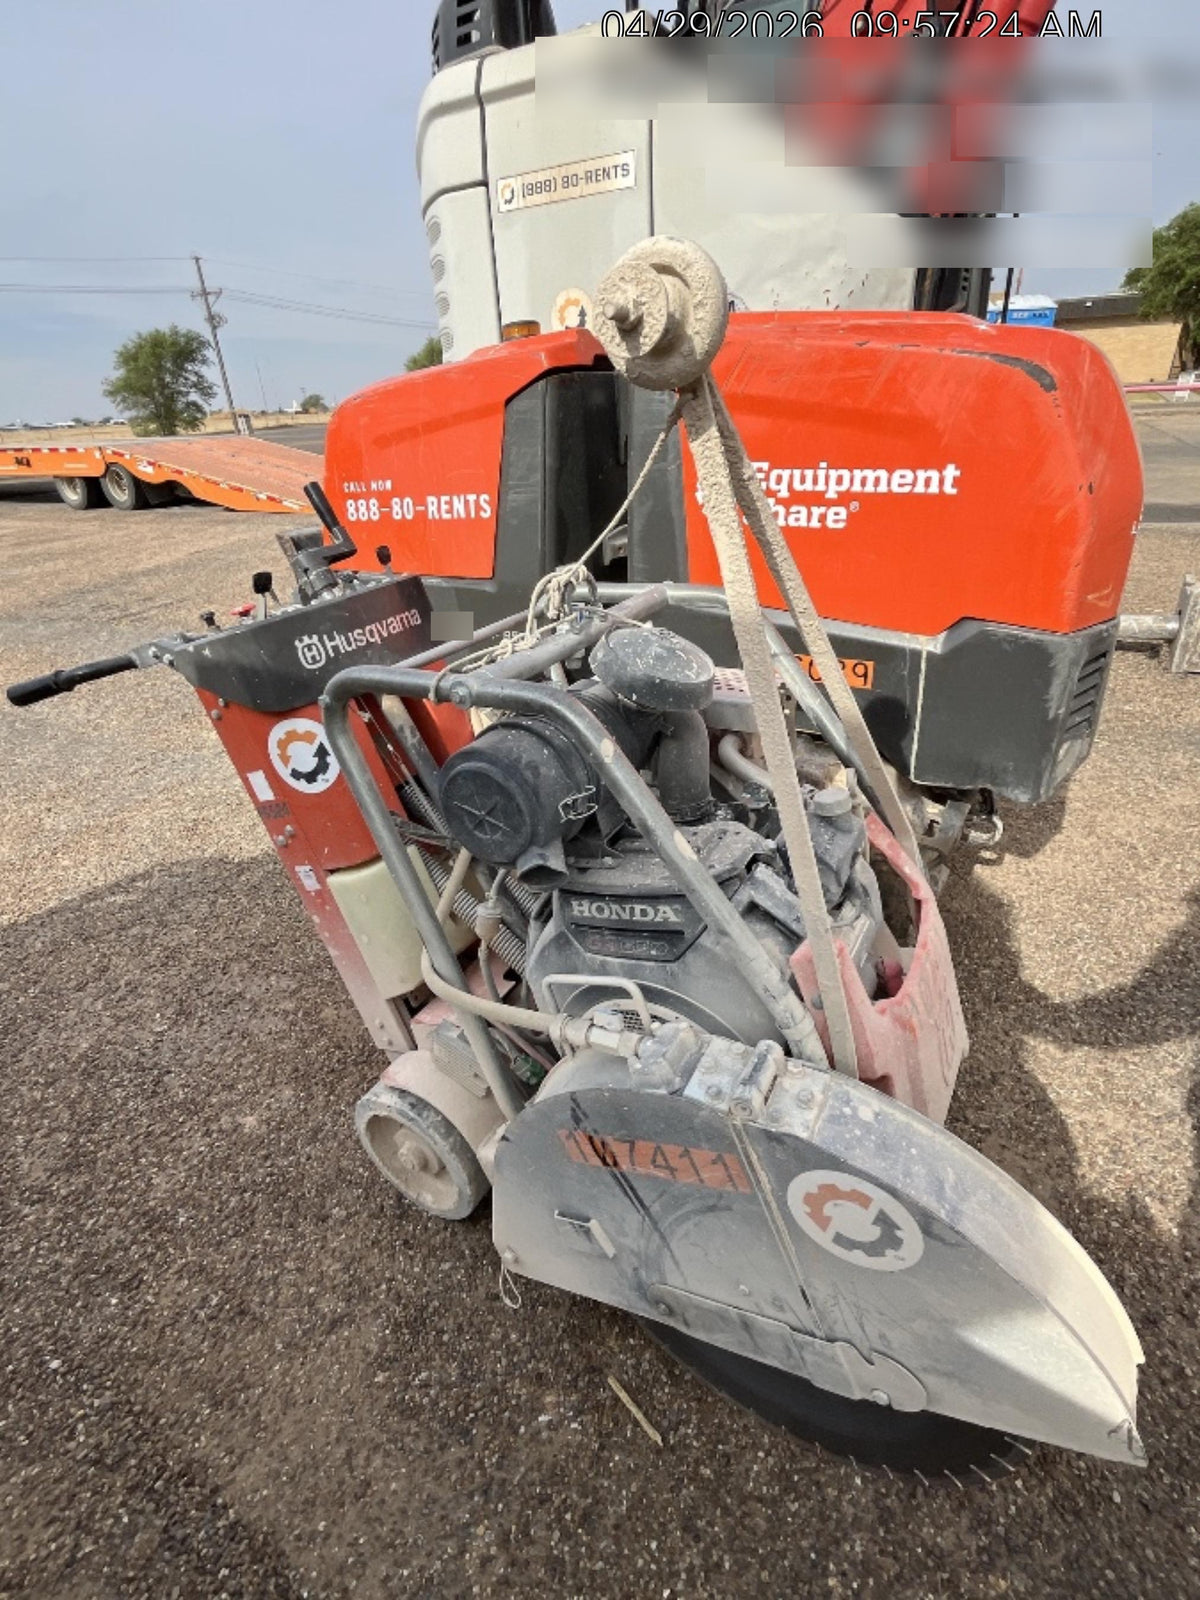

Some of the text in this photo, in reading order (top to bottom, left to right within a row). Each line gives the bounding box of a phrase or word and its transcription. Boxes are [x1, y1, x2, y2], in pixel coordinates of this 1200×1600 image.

[522, 163, 630, 198] (888) 80-RENTS
[343, 479, 392, 493] CALL NOW
[750, 461, 961, 499] Equipment
[346, 493, 492, 522] 888-80-RENTS
[323, 608, 422, 658] Husqvarna
[570, 900, 682, 923] HONDA
